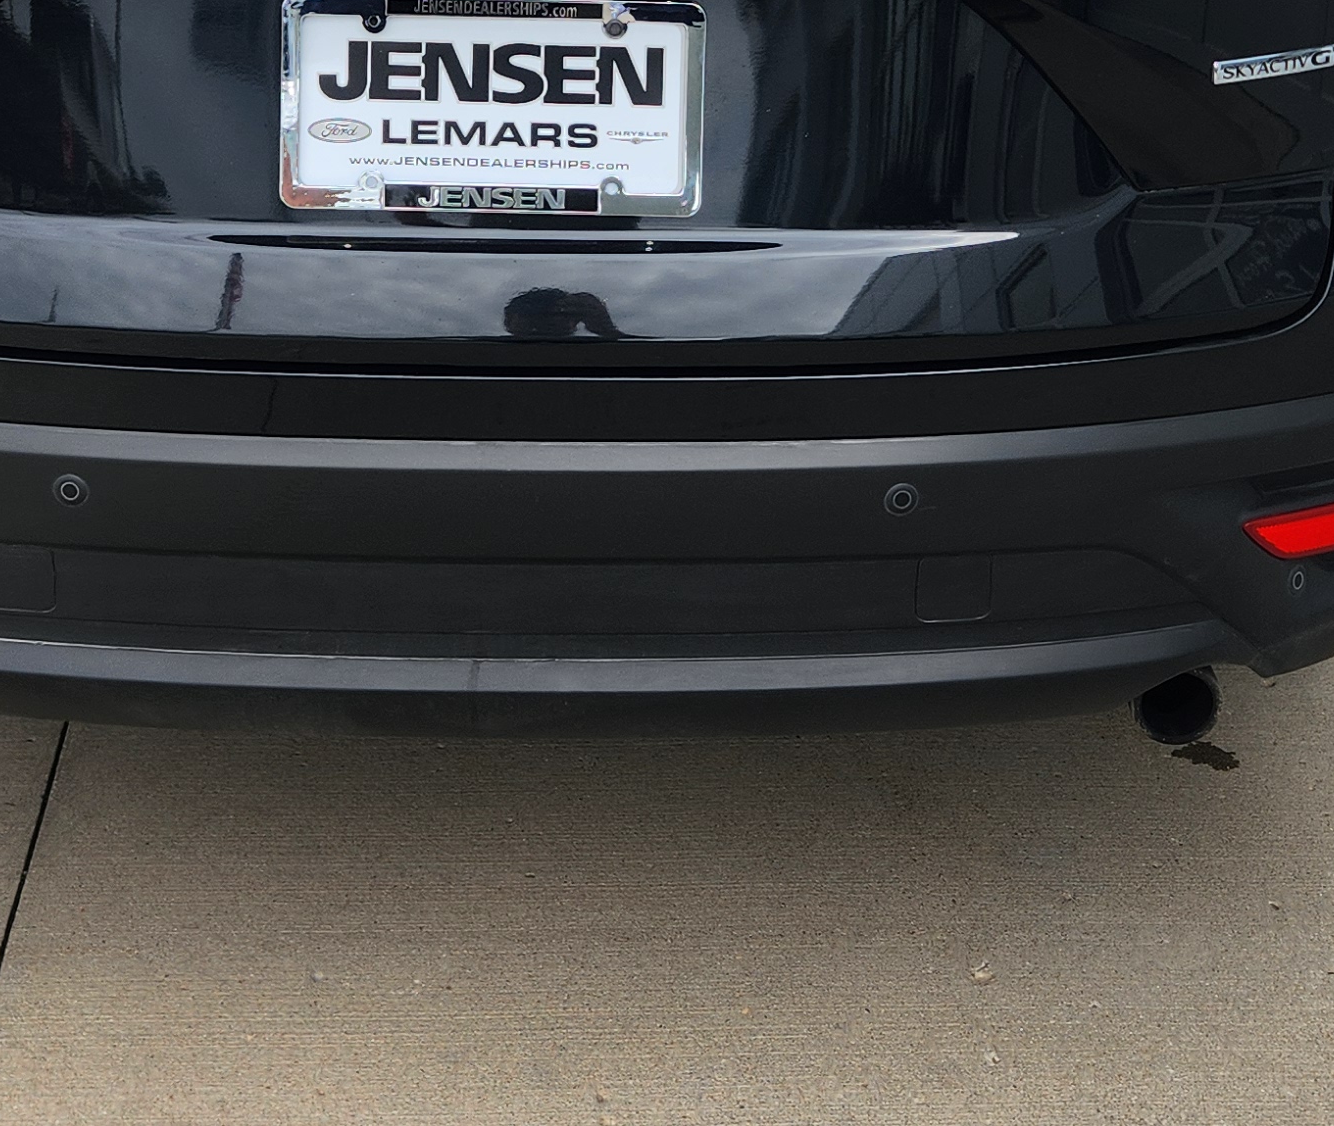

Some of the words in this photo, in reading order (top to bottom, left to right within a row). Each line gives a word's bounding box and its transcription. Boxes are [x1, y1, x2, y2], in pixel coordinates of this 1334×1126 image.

[414, 0, 578, 17] JENSENDEALERSHIPS.com
[318, 40, 665, 106] JENSEN
[382, 119, 598, 148] LEMARS
[349, 156, 630, 171] www.JENSENDEALERSHIPS.com
[417, 186, 566, 209] JENSEN
